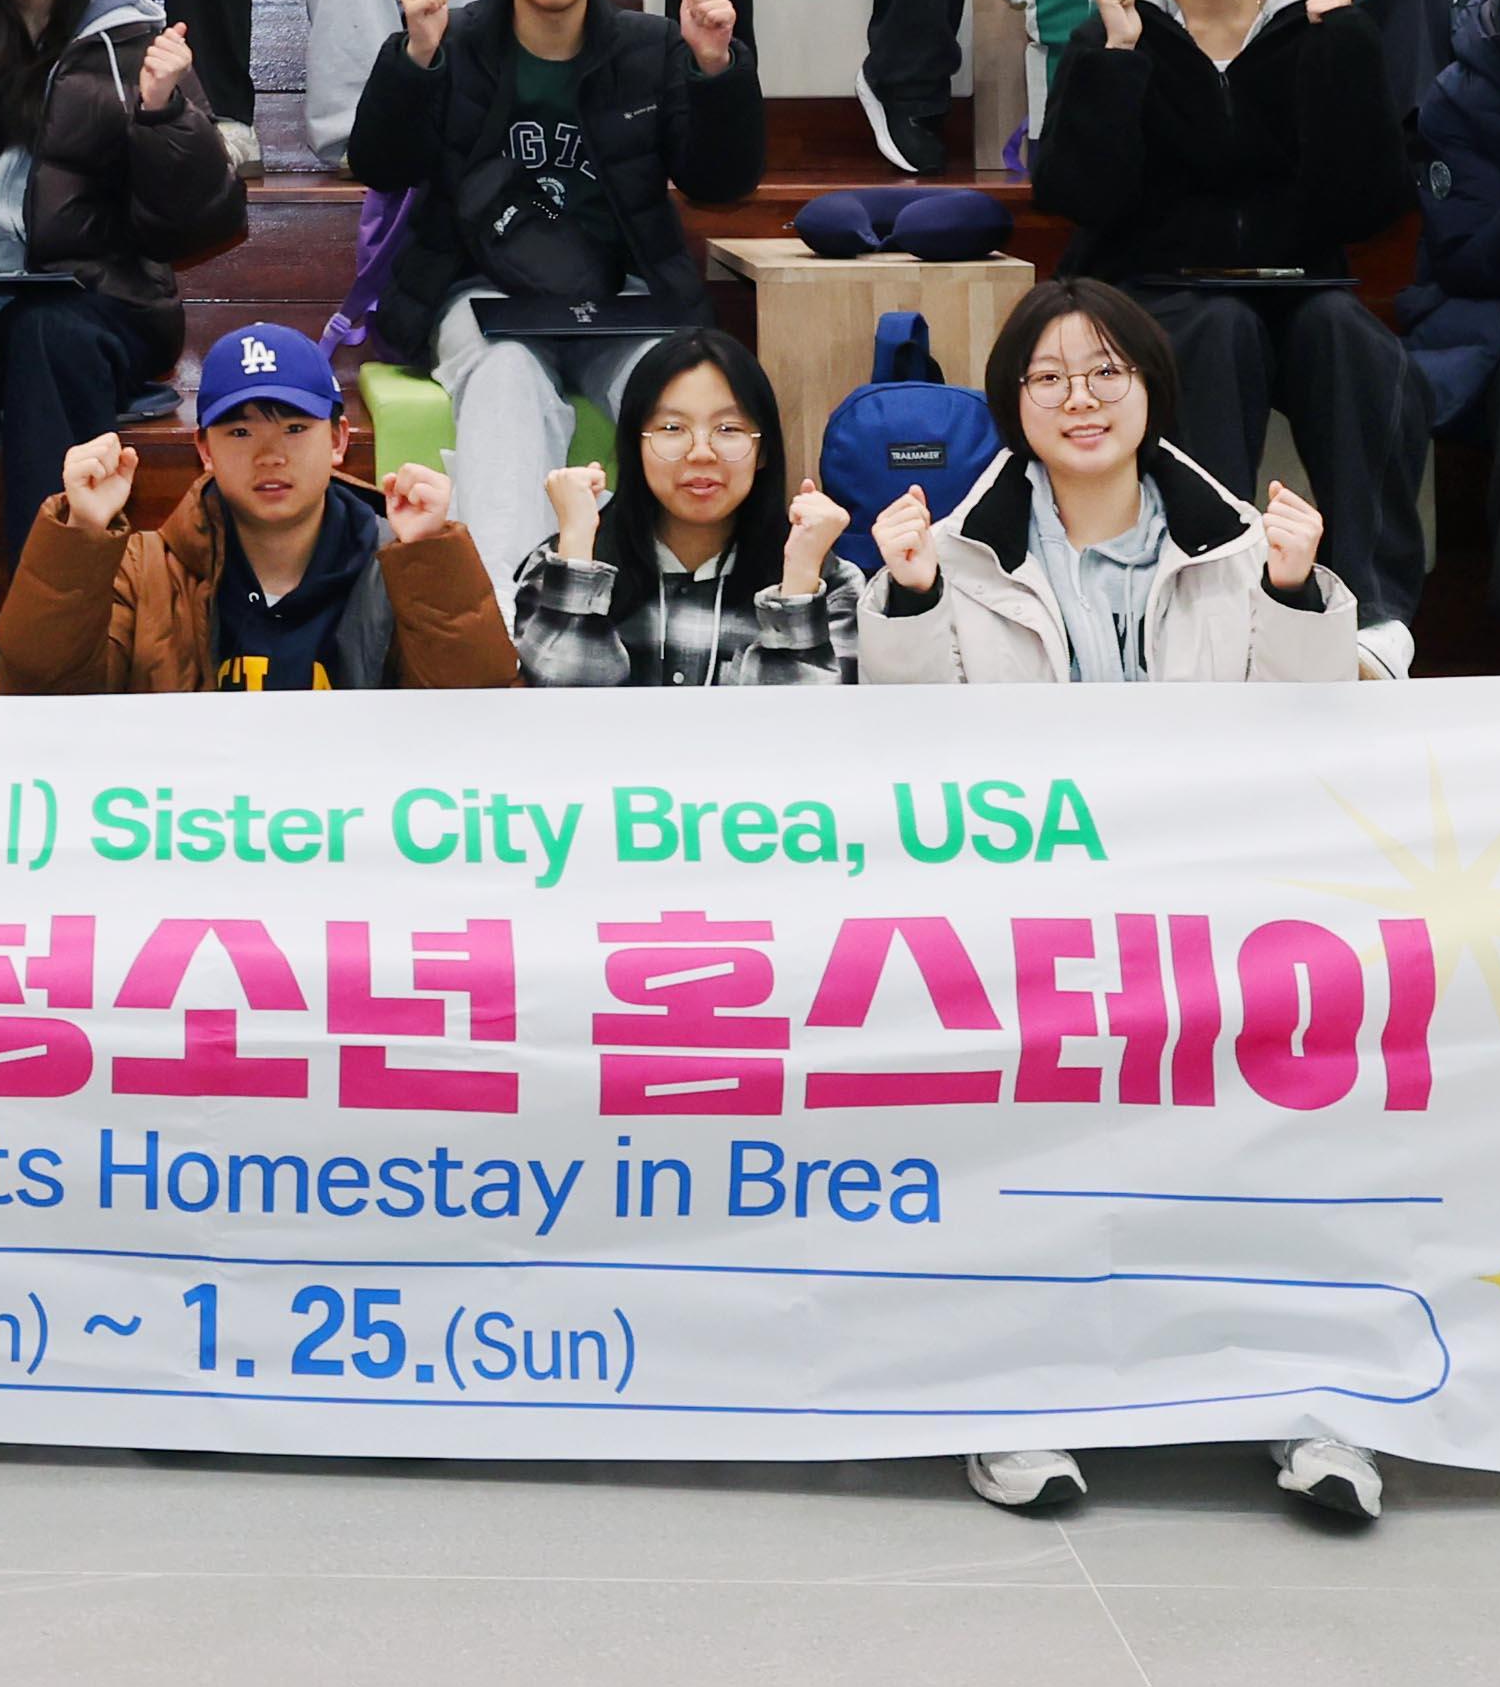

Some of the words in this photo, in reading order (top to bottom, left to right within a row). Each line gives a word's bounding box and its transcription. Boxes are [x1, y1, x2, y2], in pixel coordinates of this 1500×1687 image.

[240, 336, 278, 374] LA
[92, 788, 364, 866] Sister
[394, 788, 584, 889] City
[616, 788, 867, 877] Brea,
[896, 780, 1109, 865] USA
[590, 910, 1438, 1117] 홈스테이
[99, 1128, 586, 1237] Homestay
[616, 1136, 694, 1220] in
[729, 1141, 943, 1226] Brea
[84, 1314, 144, 1340] ~
[182, 1283, 257, 1380] 1.
[290, 1284, 637, 1394] 25.(Sun)
